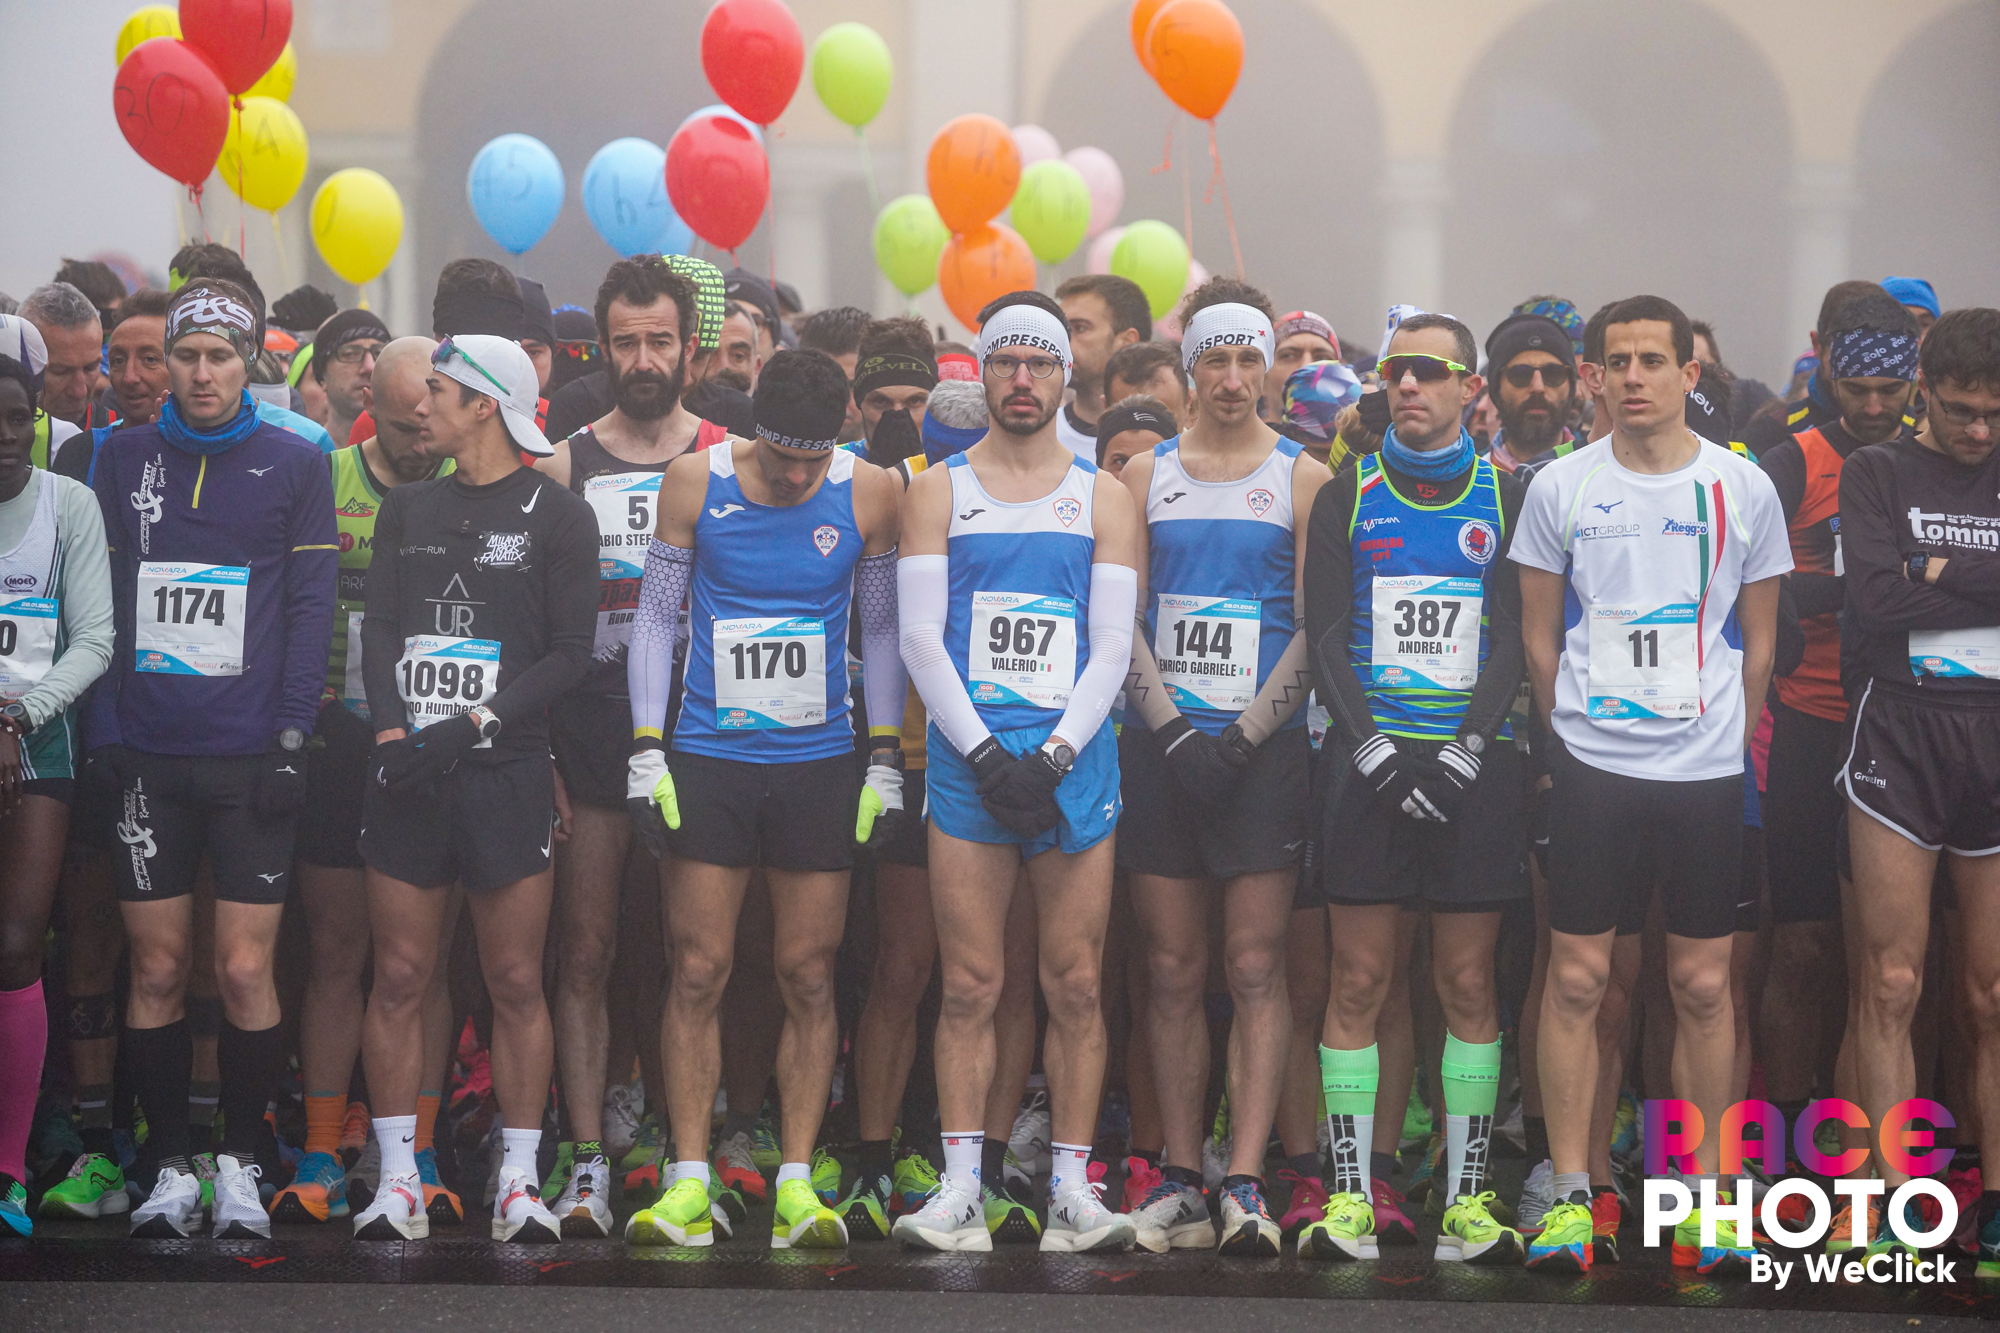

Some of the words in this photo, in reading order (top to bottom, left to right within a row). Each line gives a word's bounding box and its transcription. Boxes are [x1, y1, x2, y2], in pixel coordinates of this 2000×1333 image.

[1862, 347, 1887, 363] eolo
[1881, 354, 1904, 368] eolo
[756, 422, 839, 451] COMPRESSPO
[139, 461, 152, 501] SPORT
[594, 477, 634, 488] NOVARA
[628, 495, 650, 531] 5
[1907, 507, 2000, 547] tomm
[486, 534, 526, 548] MILANO
[625, 533, 653, 547] STEF
[1947, 541, 1997, 552] running
[147, 566, 188, 575] NOVARA
[1381, 579, 1424, 587] NOVARA
[153, 585, 226, 627] 1174
[980, 595, 1020, 604] NOVARA
[1164, 598, 1199, 608] NOVARA
[1393, 599, 1462, 639] 387
[1597, 609, 1639, 617] NOVARA
[721, 623, 763, 632] NOVARA
[988, 615, 1057, 658] 967
[1173, 619, 1233, 660] 144
[1397, 640, 1443, 655] ANDREA
[1628, 629, 1659, 668] 11
[729, 641, 807, 680] 1170
[991, 656, 1038, 673] VALERIO
[1159, 658, 1188, 674] ENRICO
[1190, 661, 1237, 677] GABRIELE
[402, 659, 485, 701] 1098
[425, 701, 482, 717] Humber
[974, 745, 993, 763] CRAFT
